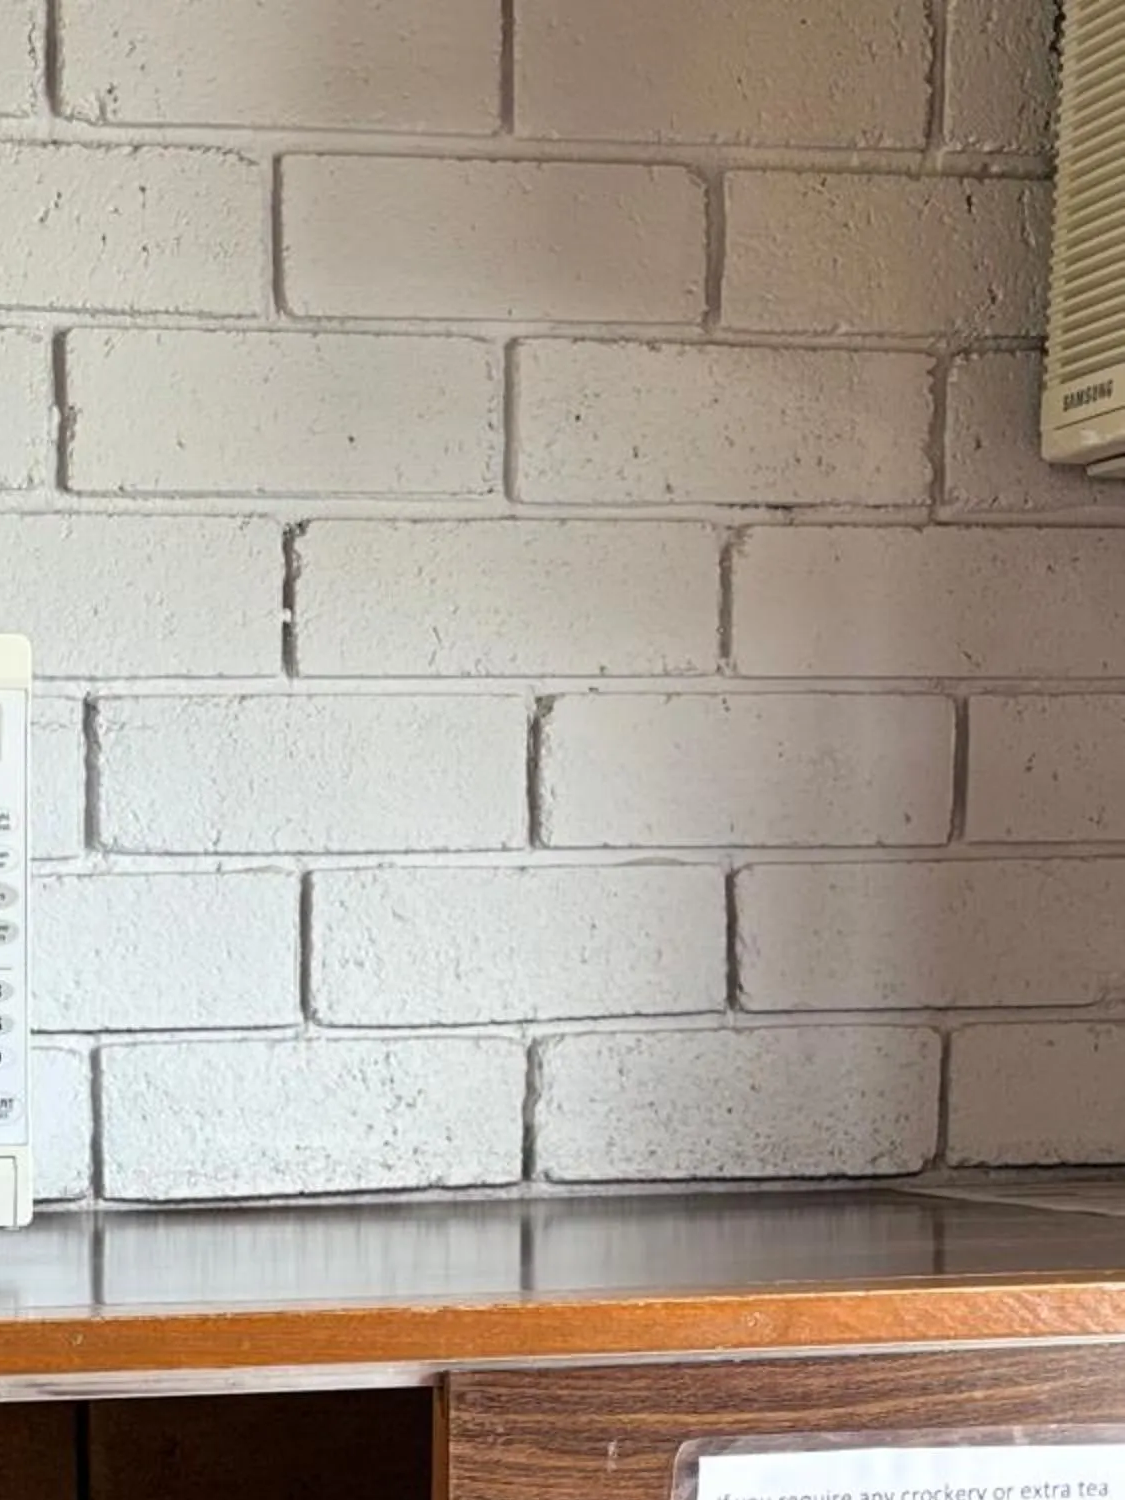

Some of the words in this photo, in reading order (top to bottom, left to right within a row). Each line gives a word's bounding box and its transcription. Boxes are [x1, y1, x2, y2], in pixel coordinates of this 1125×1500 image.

[992, 1484, 1014, 1500] or
[1020, 1481, 1072, 1500] extra
[1077, 1480, 1110, 1498] tea
